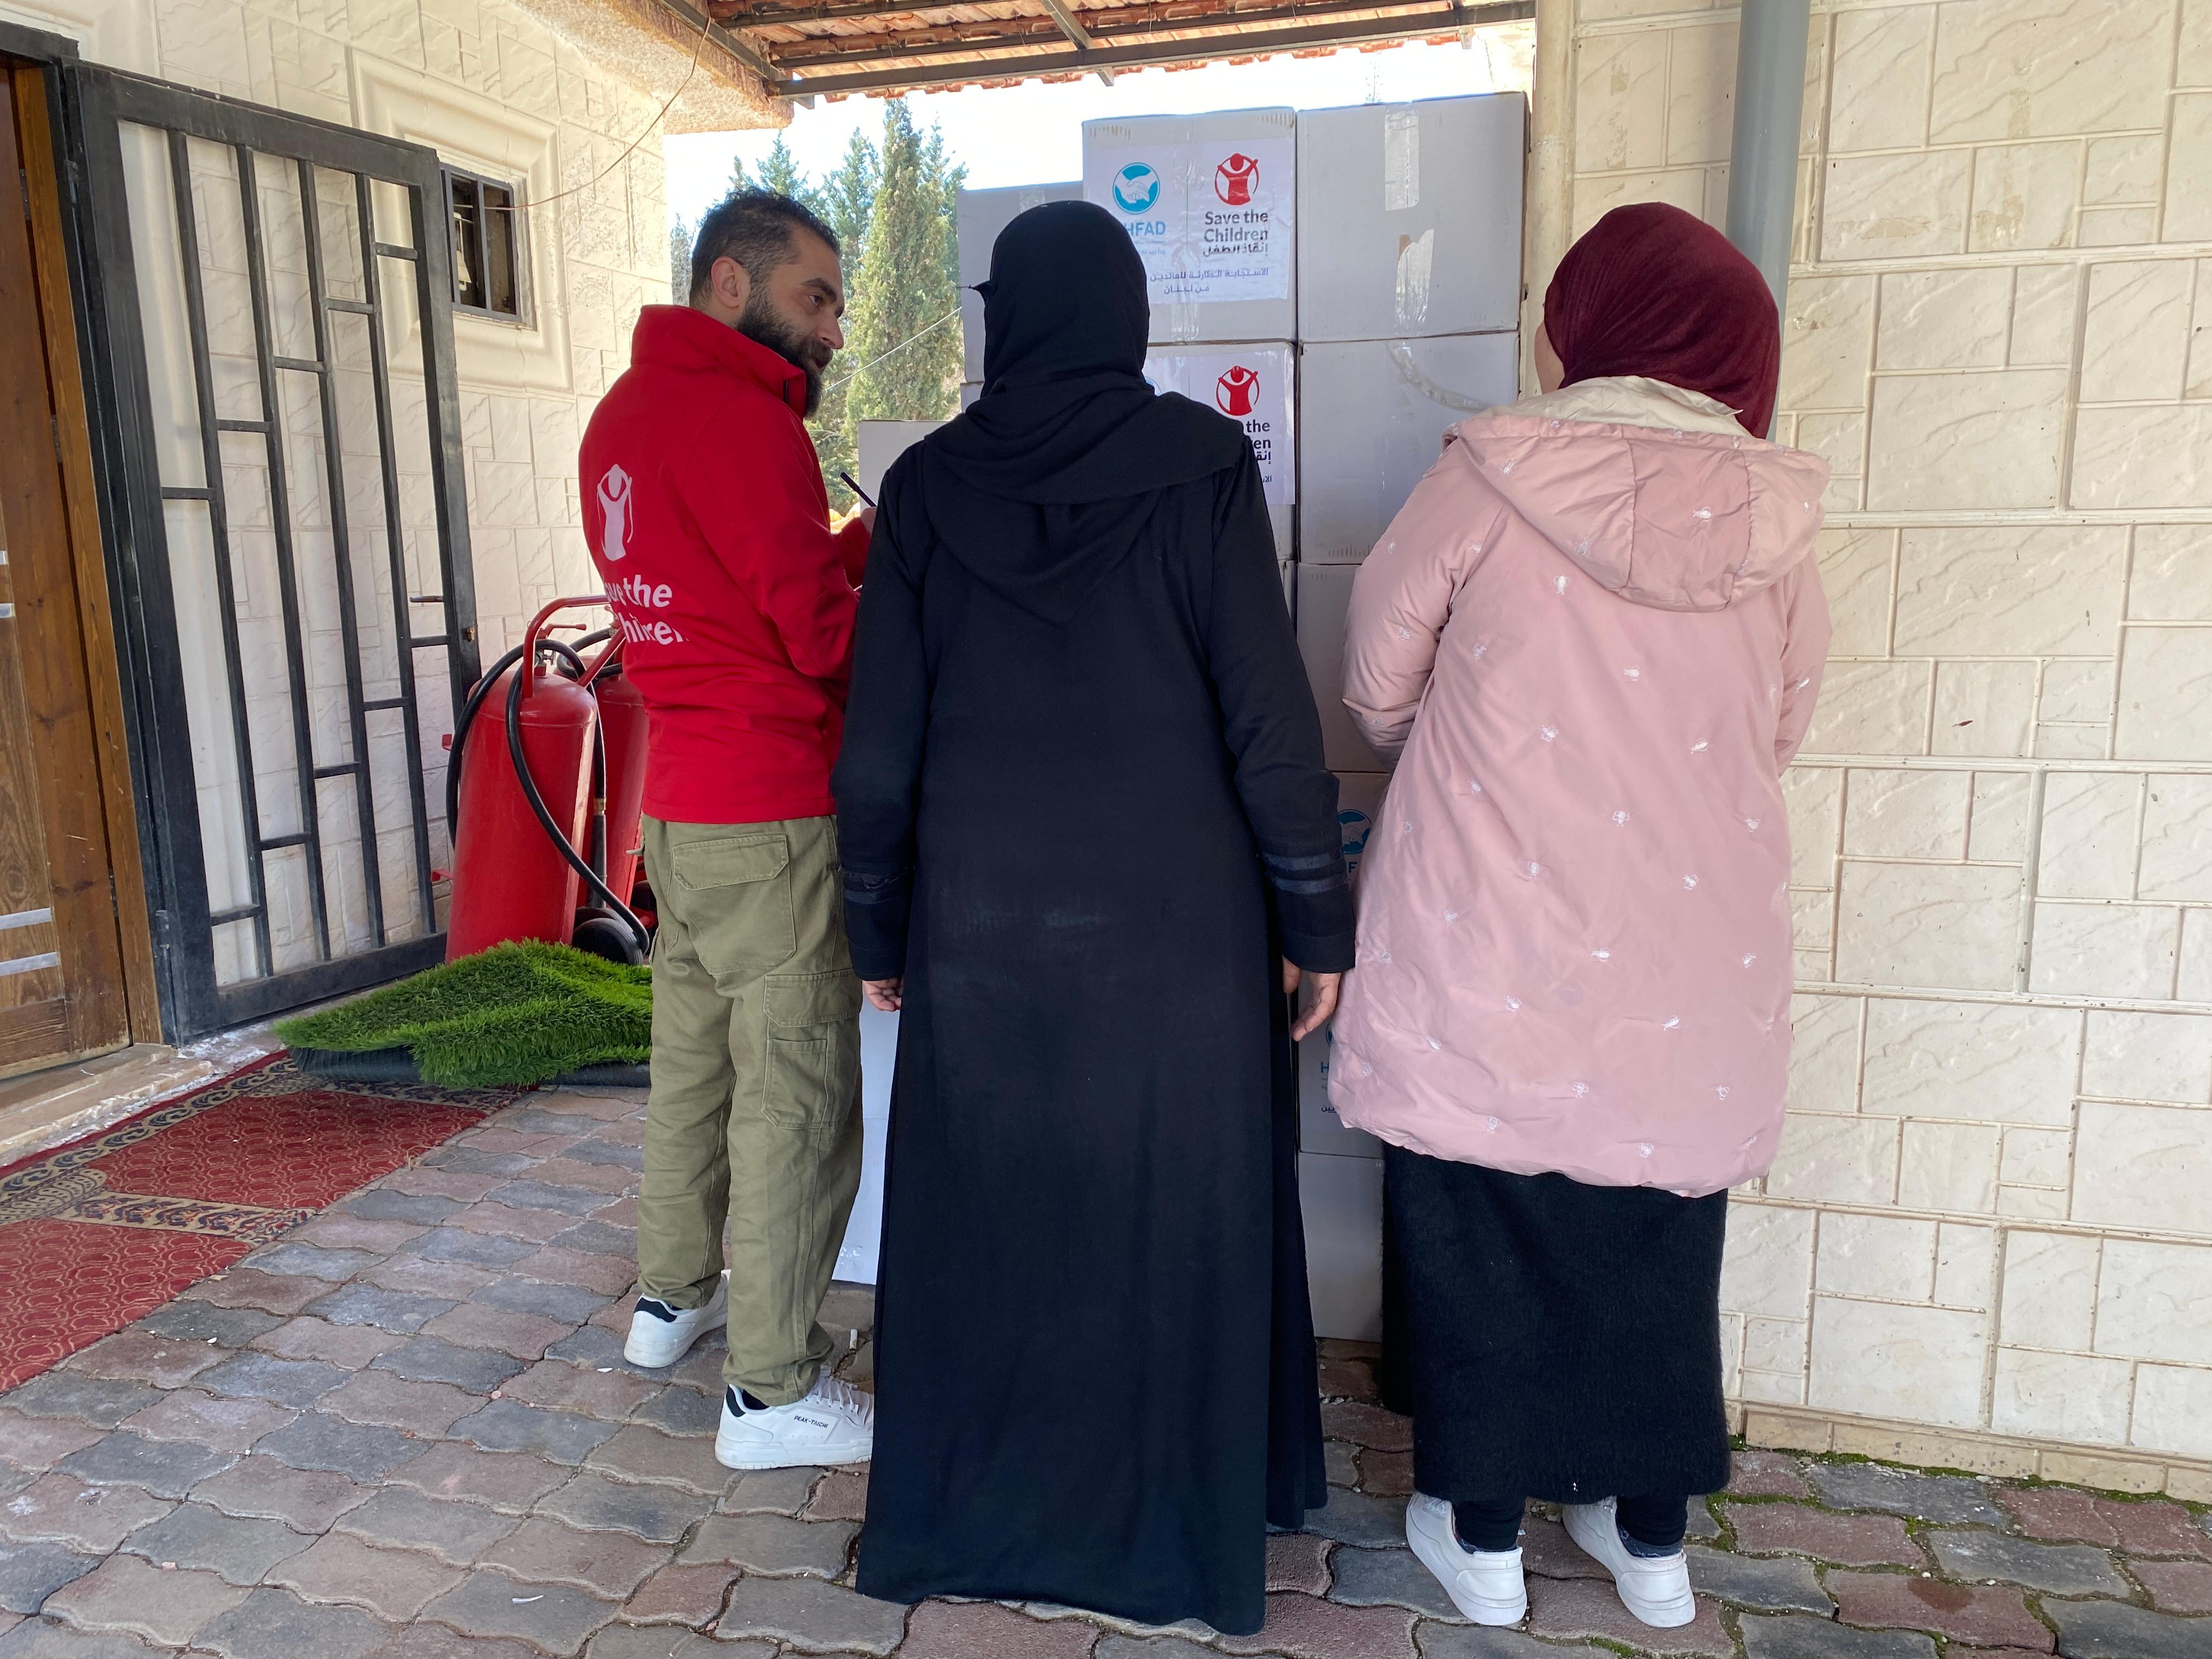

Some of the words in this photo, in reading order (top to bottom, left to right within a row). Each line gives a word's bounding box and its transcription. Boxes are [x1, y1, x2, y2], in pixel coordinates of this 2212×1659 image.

[1205, 211, 1240, 225] Save
[1244, 208, 1268, 223] the
[1204, 227, 1268, 242] Children
[1203, 244, 1240, 257] الطفل
[1242, 241, 1268, 257] إنقاذ
[1189, 269, 1222, 280] الطارئة
[1225, 267, 1268, 279] الاستجابة
[1164, 284, 1193, 294] لبنان
[1246, 419, 1270, 433] the
[604, 582, 627, 606] ave
[623, 574, 673, 607] the
